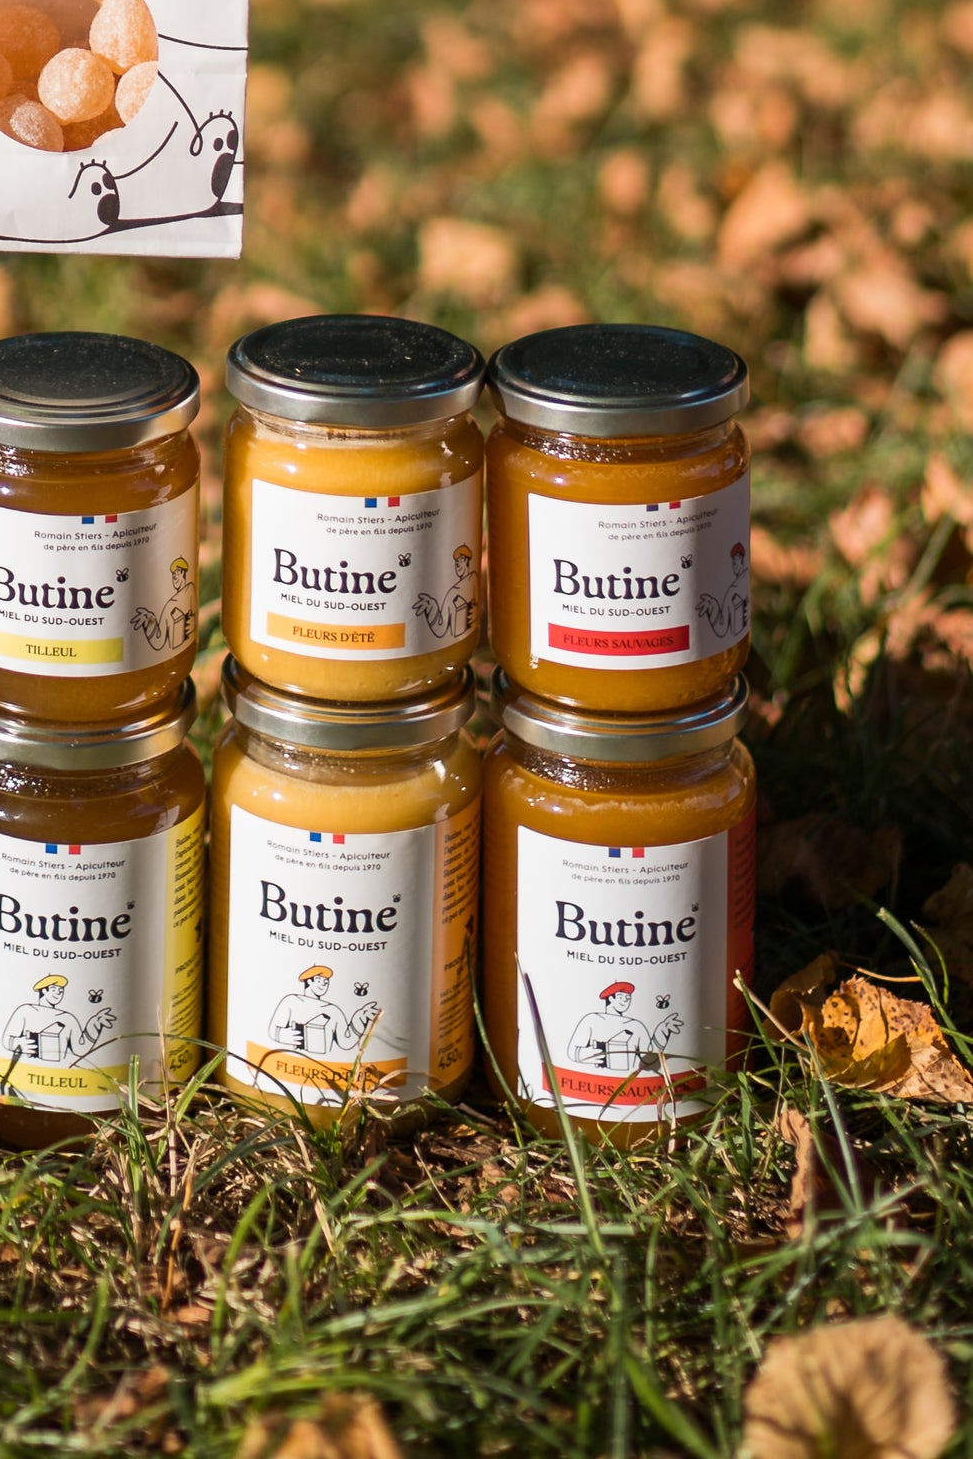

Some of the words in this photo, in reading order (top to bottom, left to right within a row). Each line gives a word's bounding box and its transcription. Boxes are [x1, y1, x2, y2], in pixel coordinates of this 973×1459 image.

[317, 513, 355, 524] Romain
[357, 515, 385, 524] Stiers
[394, 508, 440, 523] Apiculteur
[598, 520, 637, 529] Romain
[639, 520, 667, 528] Stiers
[34, 530, 72, 540] Romain
[74, 532, 102, 540] Stiers
[112, 522, 157, 539] Apiculteur
[326, 526, 337, 534] de
[339, 527, 359, 536] père
[388, 525, 415, 535] depuis
[416, 521, 433, 530] 1970
[621, 533, 641, 541] père
[669, 526, 696, 537] depuis
[43, 543, 54, 551] de
[55, 544, 76, 552] père
[105, 540, 132, 551] depuis
[133, 536, 150, 546] 1970
[273, 548, 397, 594] Butine
[553, 558, 681, 600] Butine
[280, 593, 303, 605] MIEL
[306, 598, 321, 608] DU
[324, 601, 387, 611] SUD-OUEST
[562, 603, 586, 615] MIEL
[589, 607, 605, 616] DU
[608, 605, 671, 617] SUD-OUEST
[24, 614, 39, 623] DU
[42, 617, 105, 626] SUD-OUEST
[292, 625, 338, 642] FLEURS
[563, 634, 609, 649] FLEURS
[611, 636, 674, 649] SAUVAGES
[25, 644, 77, 657] TILLEUL
[267, 840, 301, 855] Romain
[303, 848, 330, 859] Stiers
[339, 850, 391, 861] Apiculteur
[1, 852, 36, 867] Romain
[38, 860, 65, 870] Stiers
[75, 859, 126, 871] Apiculteur
[275, 853, 284, 861] de
[285, 857, 304, 866] père
[306, 860, 316, 868] en
[332, 863, 361, 871] depuis
[362, 863, 381, 871] 1970
[562, 858, 599, 872] Romain
[601, 865, 629, 874] Stiers
[639, 860, 689, 874] Apiculteur
[9, 867, 19, 875] de
[21, 870, 39, 879] père
[68, 874, 96, 882] depuis
[97, 871, 116, 880] 1970
[571, 873, 582, 881] de
[583, 875, 603, 885] père
[632, 876, 661, 886] depuis
[662, 873, 681, 883] 1970
[259, 880, 398, 933] Butine
[554, 900, 697, 947] Butine
[269, 929, 294, 945] MIEL
[298, 937, 314, 949] DU
[318, 941, 387, 952] SUD-OUEST
[3, 941, 29, 956] MIEL
[33, 948, 49, 959] DU
[53, 947, 122, 960] SUD-OUEST
[566, 949, 594, 963] MIEL
[598, 955, 615, 965] DU
[619, 951, 688, 966] SUD-OUEST
[276, 1060, 327, 1081] FLEURS
[27, 1073, 87, 1089] TILLEUL
[561, 1077, 614, 1096] FLEURS
